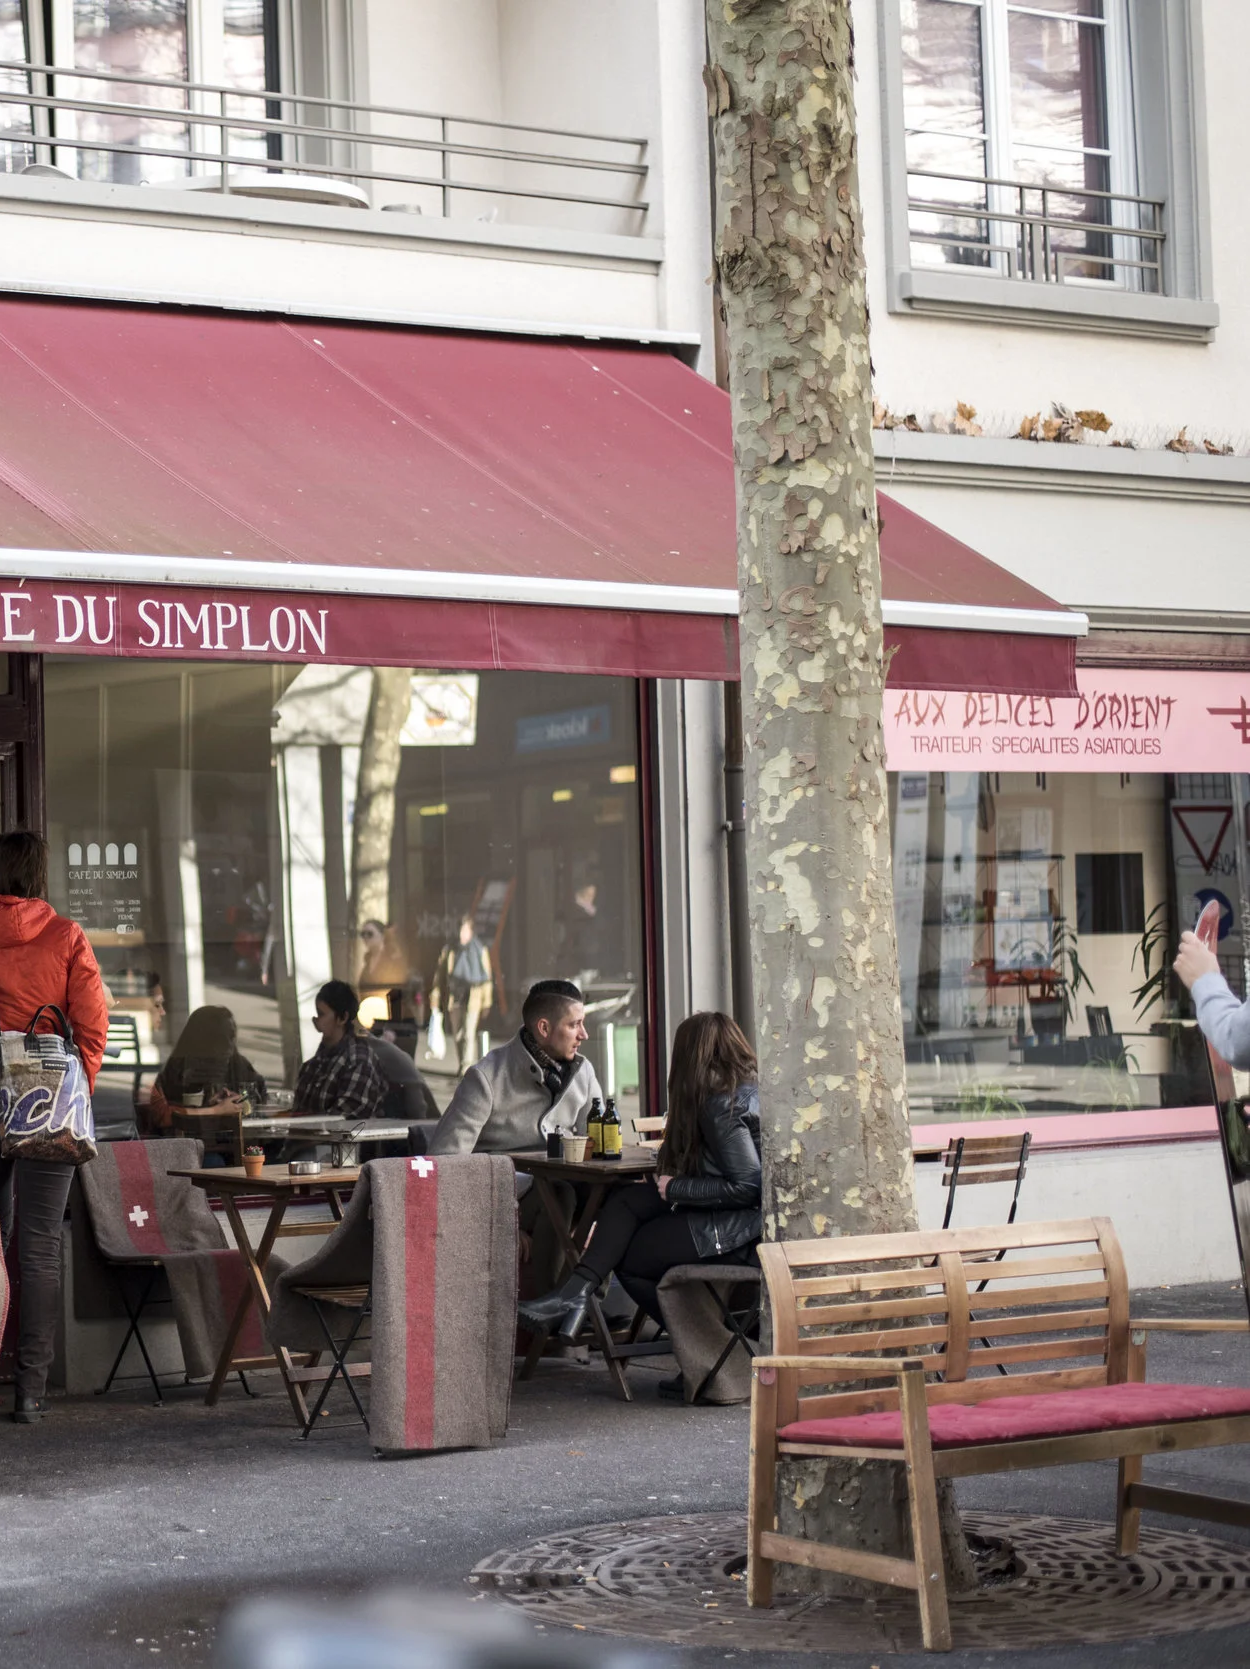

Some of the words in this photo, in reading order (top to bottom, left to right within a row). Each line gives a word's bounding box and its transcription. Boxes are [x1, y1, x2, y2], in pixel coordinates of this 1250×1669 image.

[51, 594, 117, 645] DU
[137, 598, 329, 655] SIMPLON
[894, 691, 948, 728] AUX
[962, 693, 1056, 729] DELICES
[1073, 690, 1178, 732] D'ORIENT
[910, 735, 981, 754] TRAITEUR
[992, 736, 1079, 755] SPECIALITES
[1084, 738, 1162, 756] ASIATIQUES
[94, 870, 104, 880] DU
[106, 870, 138, 881] SIMPLON
